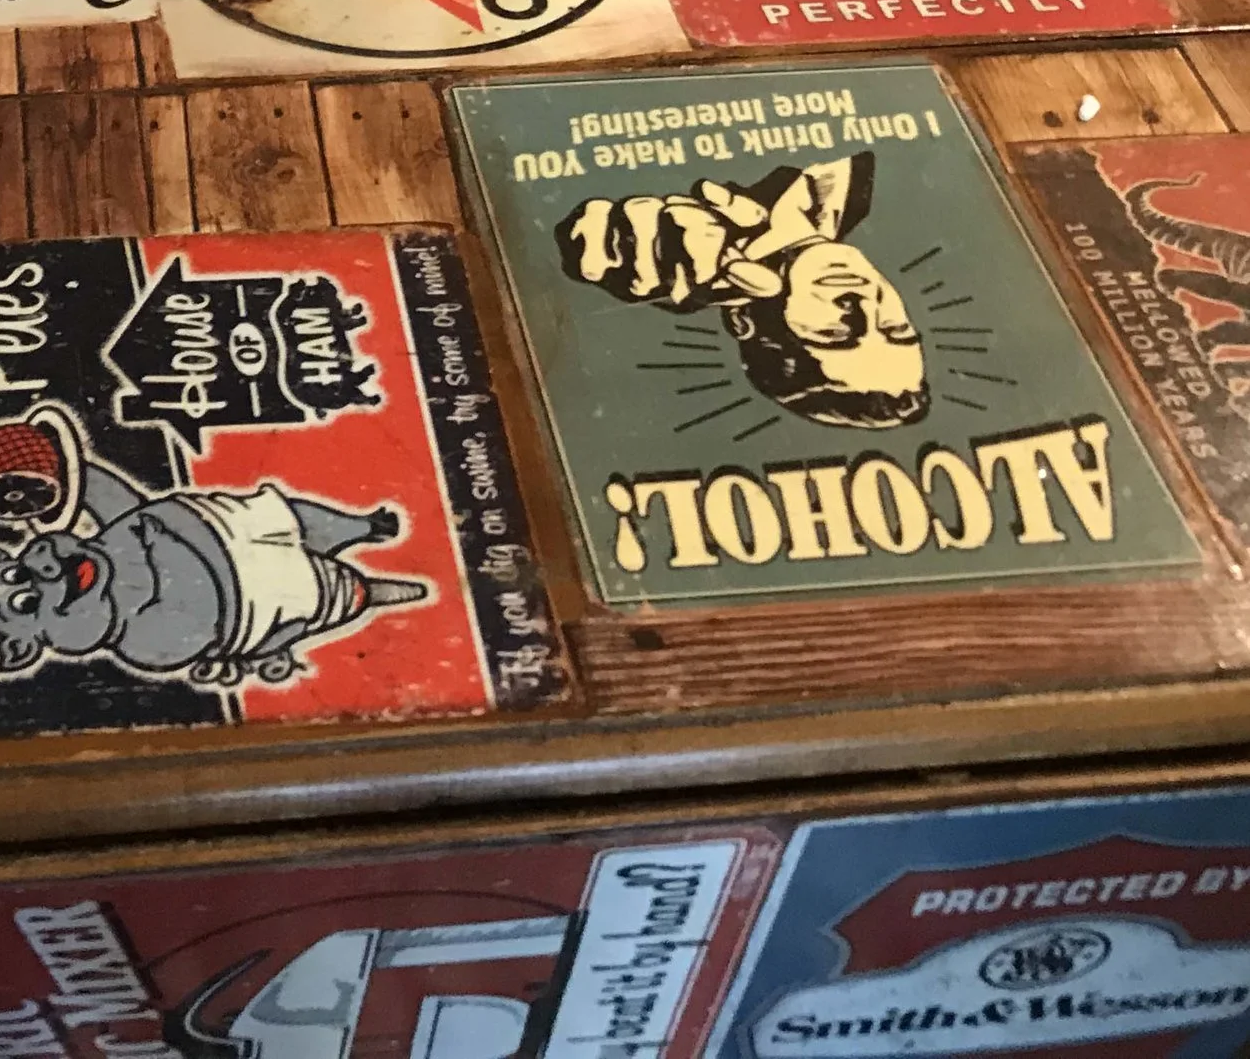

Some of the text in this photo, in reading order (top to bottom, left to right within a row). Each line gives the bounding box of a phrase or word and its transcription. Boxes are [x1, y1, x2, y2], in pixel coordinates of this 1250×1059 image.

[570, 90, 855, 144] More Interesting!
[513, 111, 941, 183] I Only Drink To Make YOU
[403, 245, 448, 297] mine!
[415, 300, 463, 329] of
[1123, 269, 1212, 402] MELLOWED
[233, 335, 264, 366] OF
[294, 308, 342, 383] HAM
[436, 340, 475, 389] some
[1065, 222, 1218, 459] 100 MILLION YEARS
[445, 392, 491, 425] try
[604, 414, 1113, 573] ALCOHOL!
[479, 507, 507, 536] on
[477, 541, 529, 582] dig
[500, 592, 547, 636] you
[912, 870, 1186, 919] PROTECTED
[14, 899, 160, 1028] MIXER
